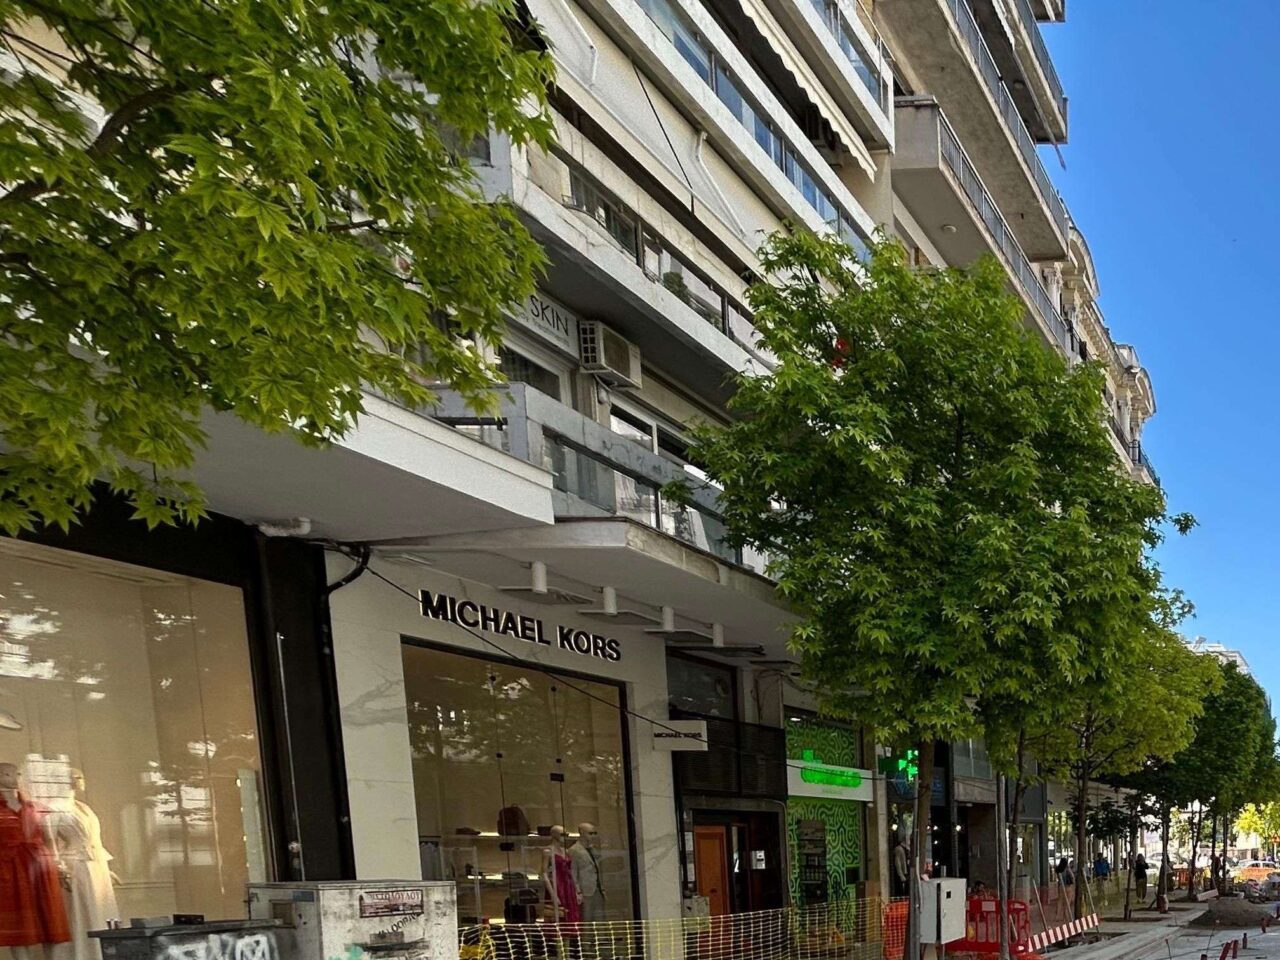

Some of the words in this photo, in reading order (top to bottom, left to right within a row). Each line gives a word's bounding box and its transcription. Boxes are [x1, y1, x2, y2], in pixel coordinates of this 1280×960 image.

[530, 294, 569, 337] SKIN
[418, 589, 551, 646] MICHAEL
[556, 625, 622, 663] KORS
